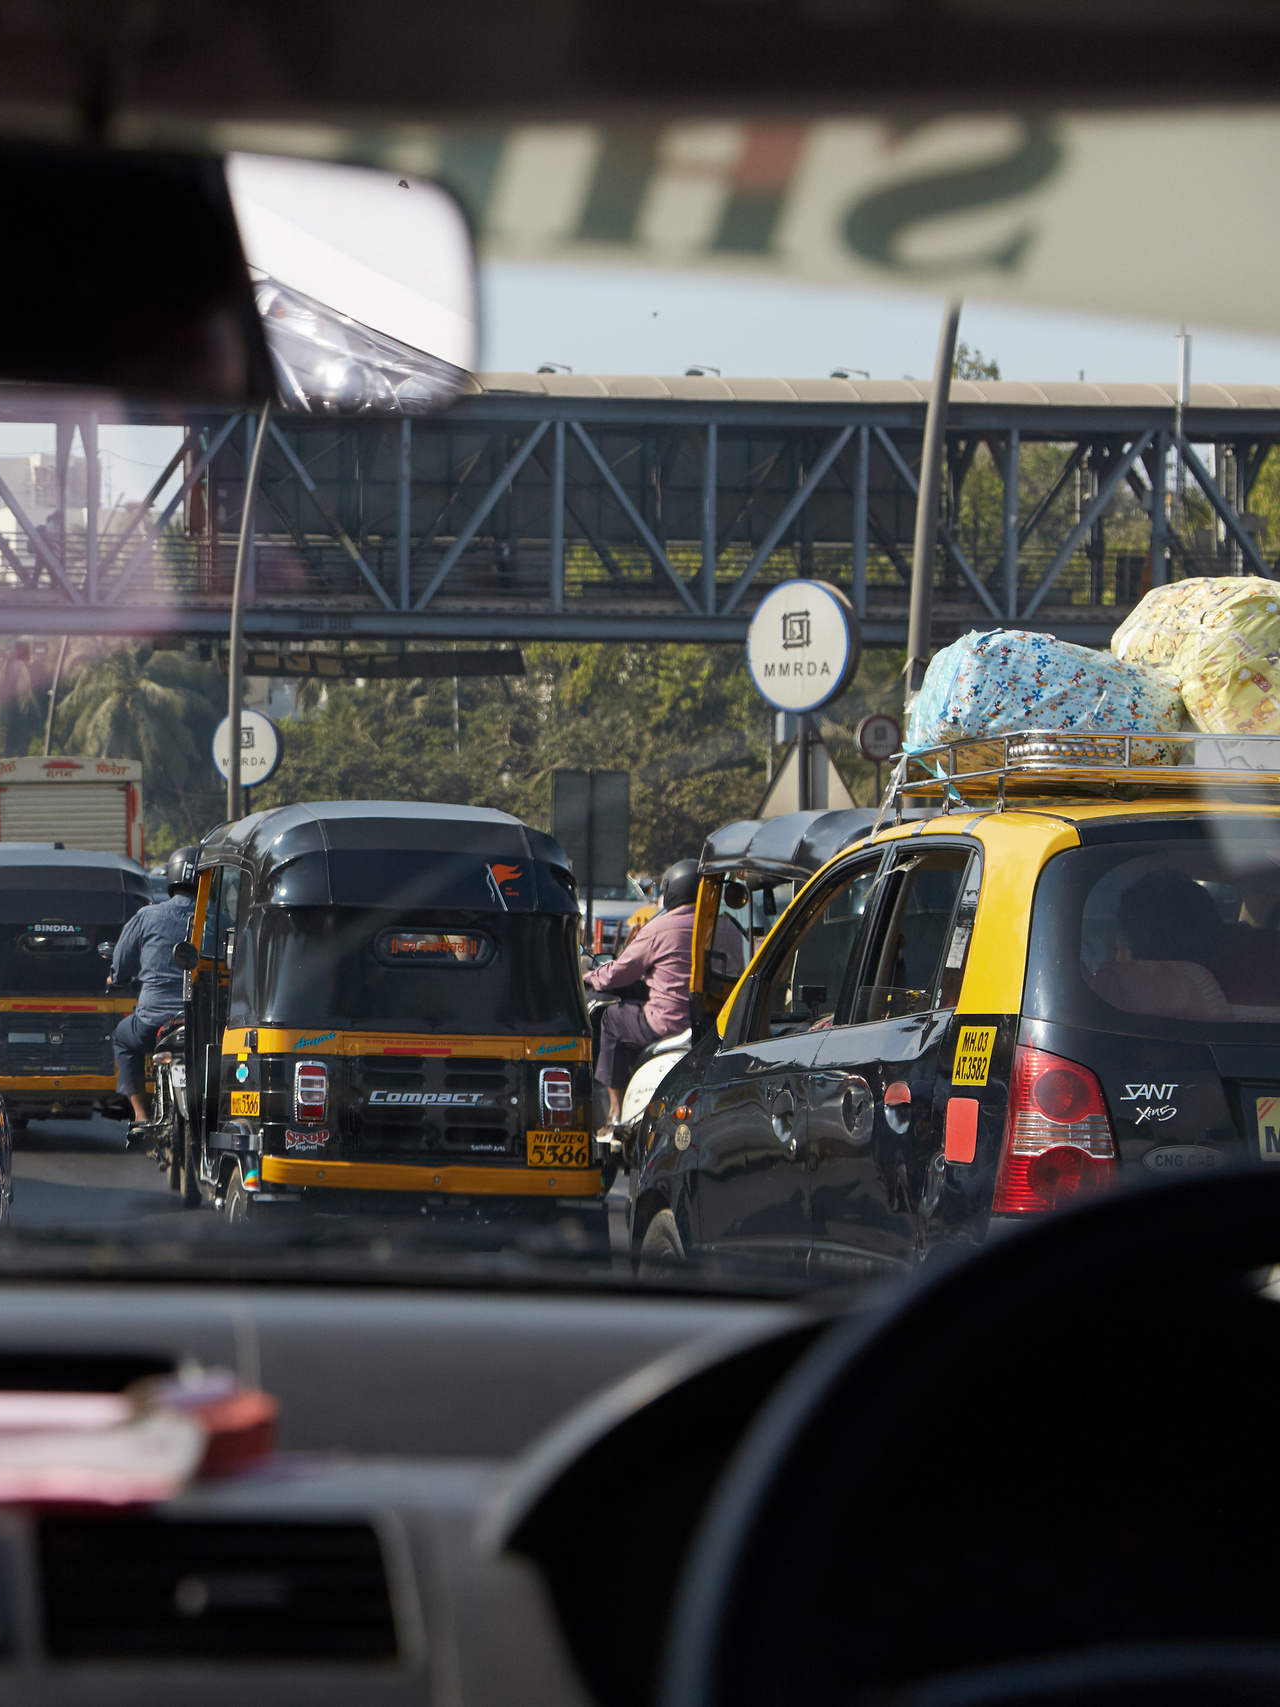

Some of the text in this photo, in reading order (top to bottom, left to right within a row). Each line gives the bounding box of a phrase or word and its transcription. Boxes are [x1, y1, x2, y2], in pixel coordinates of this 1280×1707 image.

[764, 661, 831, 677] MMRDA
[222, 757, 267, 767] MRDA
[34, 924, 75, 933] BINDRA
[292, 1032, 336, 1053] Aryan
[533, 1037, 578, 1058] Adarsh
[962, 1031, 990, 1053] MH.03
[955, 1056, 988, 1081] AT.3582
[368, 1090, 484, 1106] Compact
[285, 1129, 330, 1149] STOP
[295, 1143, 318, 1152] Signal
[529, 1145, 588, 1165] 5386
[1155, 1154, 1183, 1167] CNG
